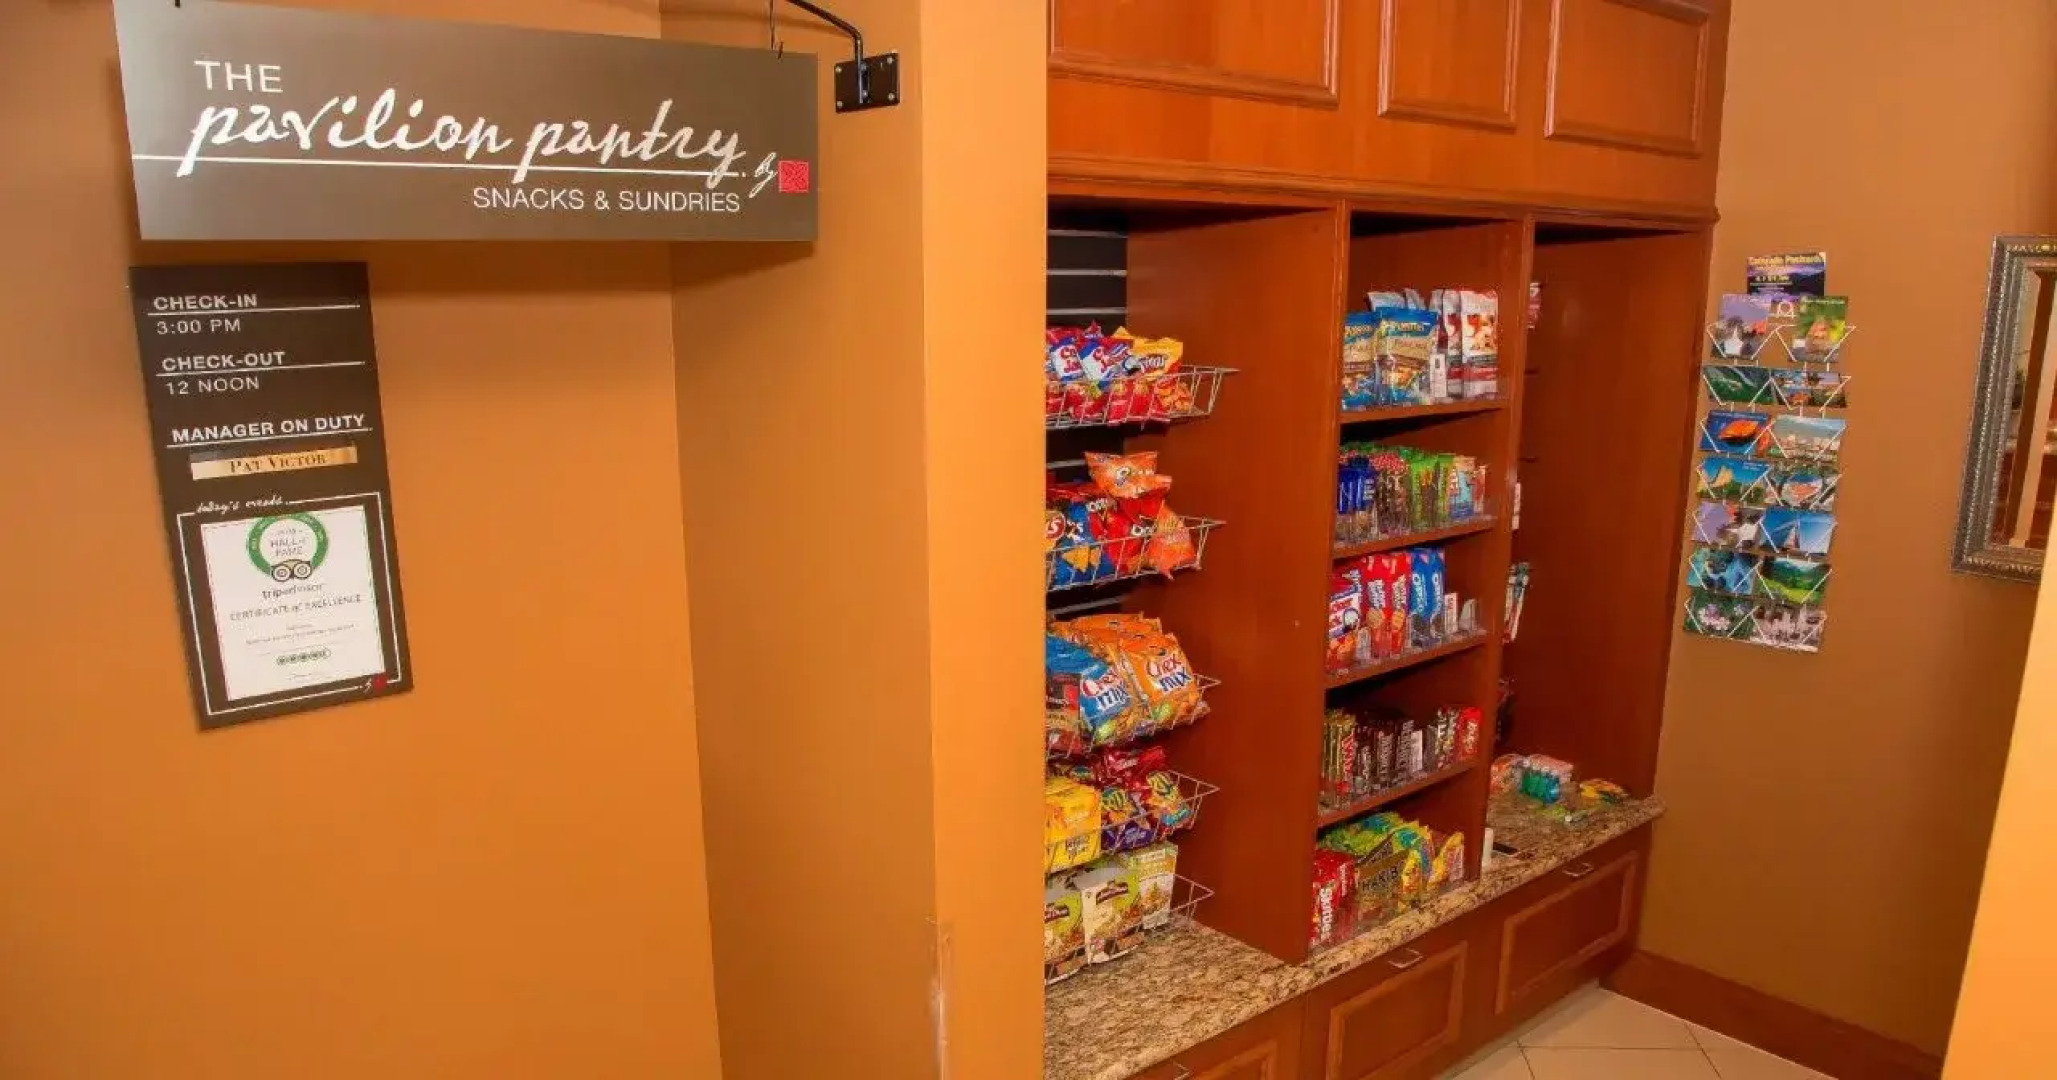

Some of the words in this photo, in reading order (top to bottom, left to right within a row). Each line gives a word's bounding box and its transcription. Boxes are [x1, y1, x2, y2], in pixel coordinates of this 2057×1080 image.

[195, 60, 283, 93] THE
[177, 88, 512, 178] pavilion
[504, 98, 746, 190] pantry
[472, 186, 585, 211] SNACKS
[594, 190, 611, 211] &
[618, 190, 741, 214] SUNDRIES
[153, 294, 258, 311] CHECK-IN
[157, 320, 202, 335] 3:00
[210, 318, 241, 333] PM
[162, 351, 286, 372] CHECK-OUT
[166, 381, 190, 395] 12
[198, 376, 260, 394] NOON
[171, 422, 275, 444] MANAGER
[281, 419, 308, 434] ON
[315, 414, 366, 432] DUTY
[1158, 667, 1192, 693] mix
